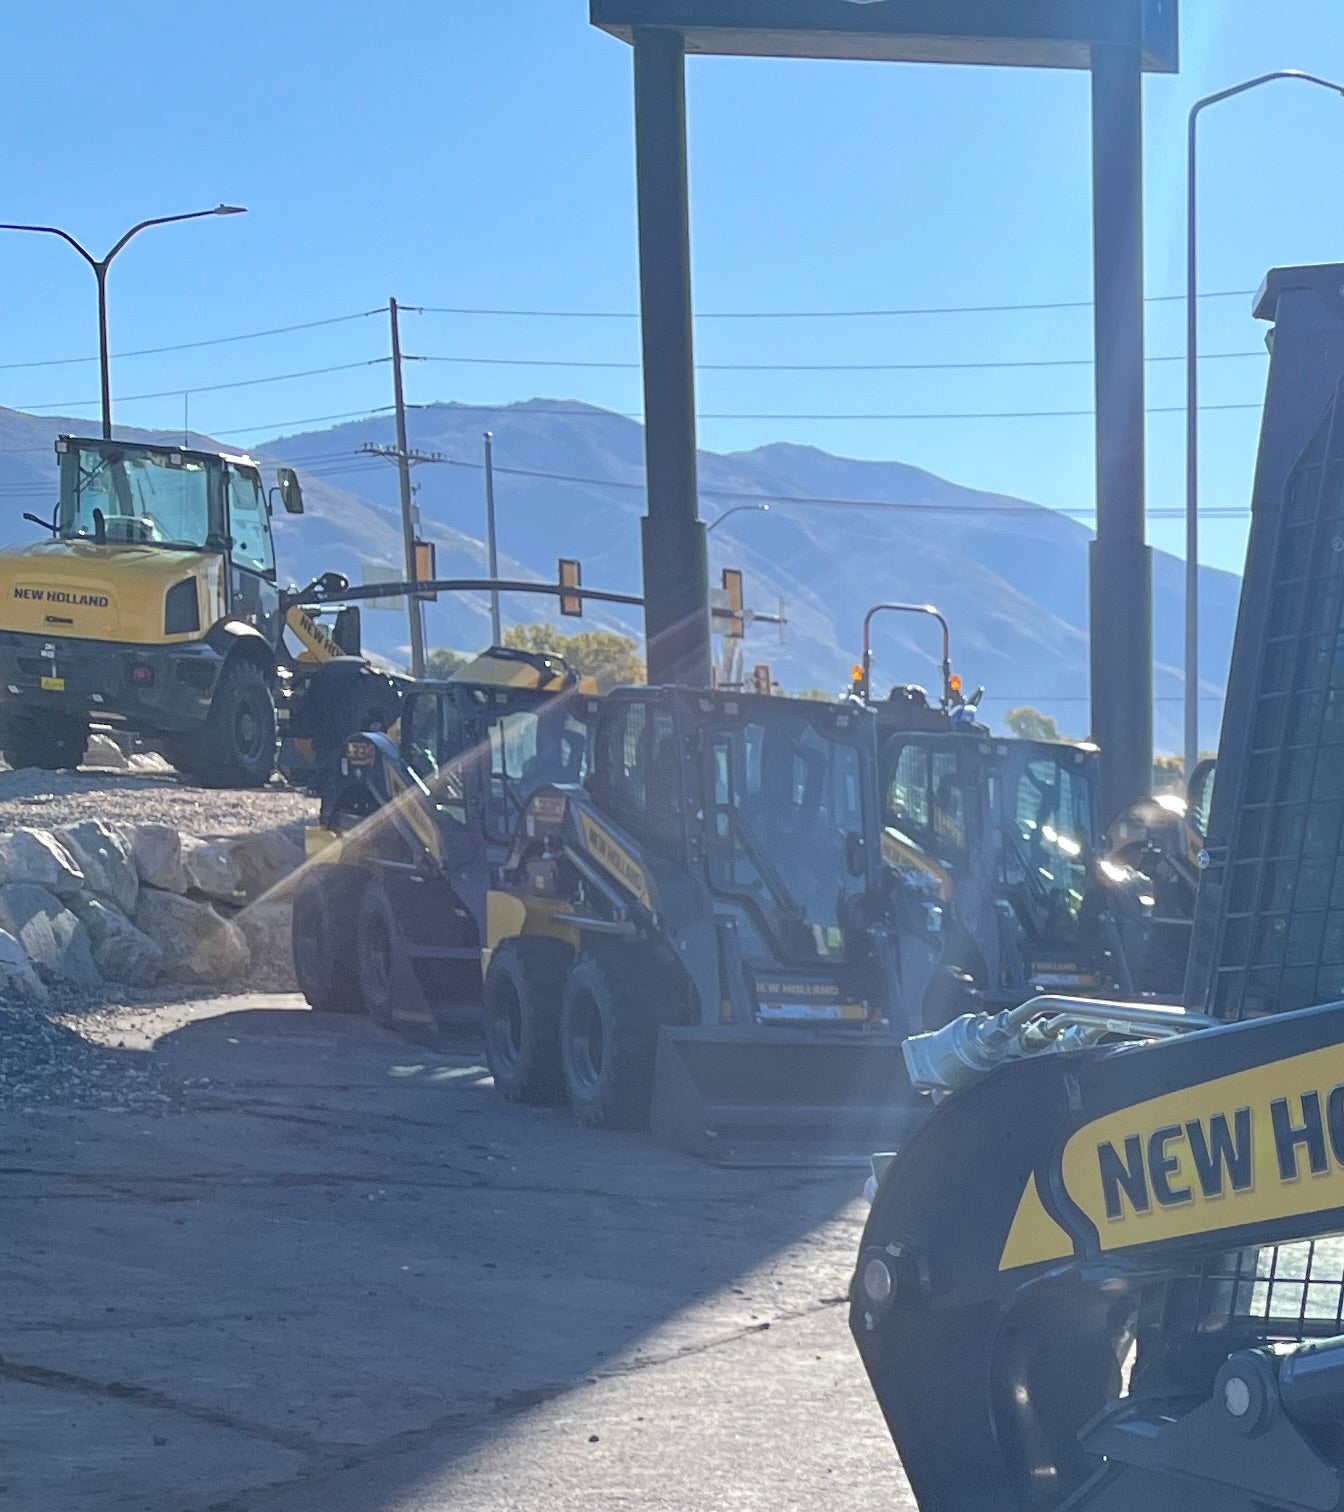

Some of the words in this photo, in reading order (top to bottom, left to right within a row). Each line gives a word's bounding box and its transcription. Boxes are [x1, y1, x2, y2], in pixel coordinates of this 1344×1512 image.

[14, 588, 44, 600] NEW
[47, 591, 109, 608] HOLLAND
[300, 614, 325, 645] NEW
[782, 983, 840, 996] HOLLAND
[1096, 1106, 1253, 1221] NEW
